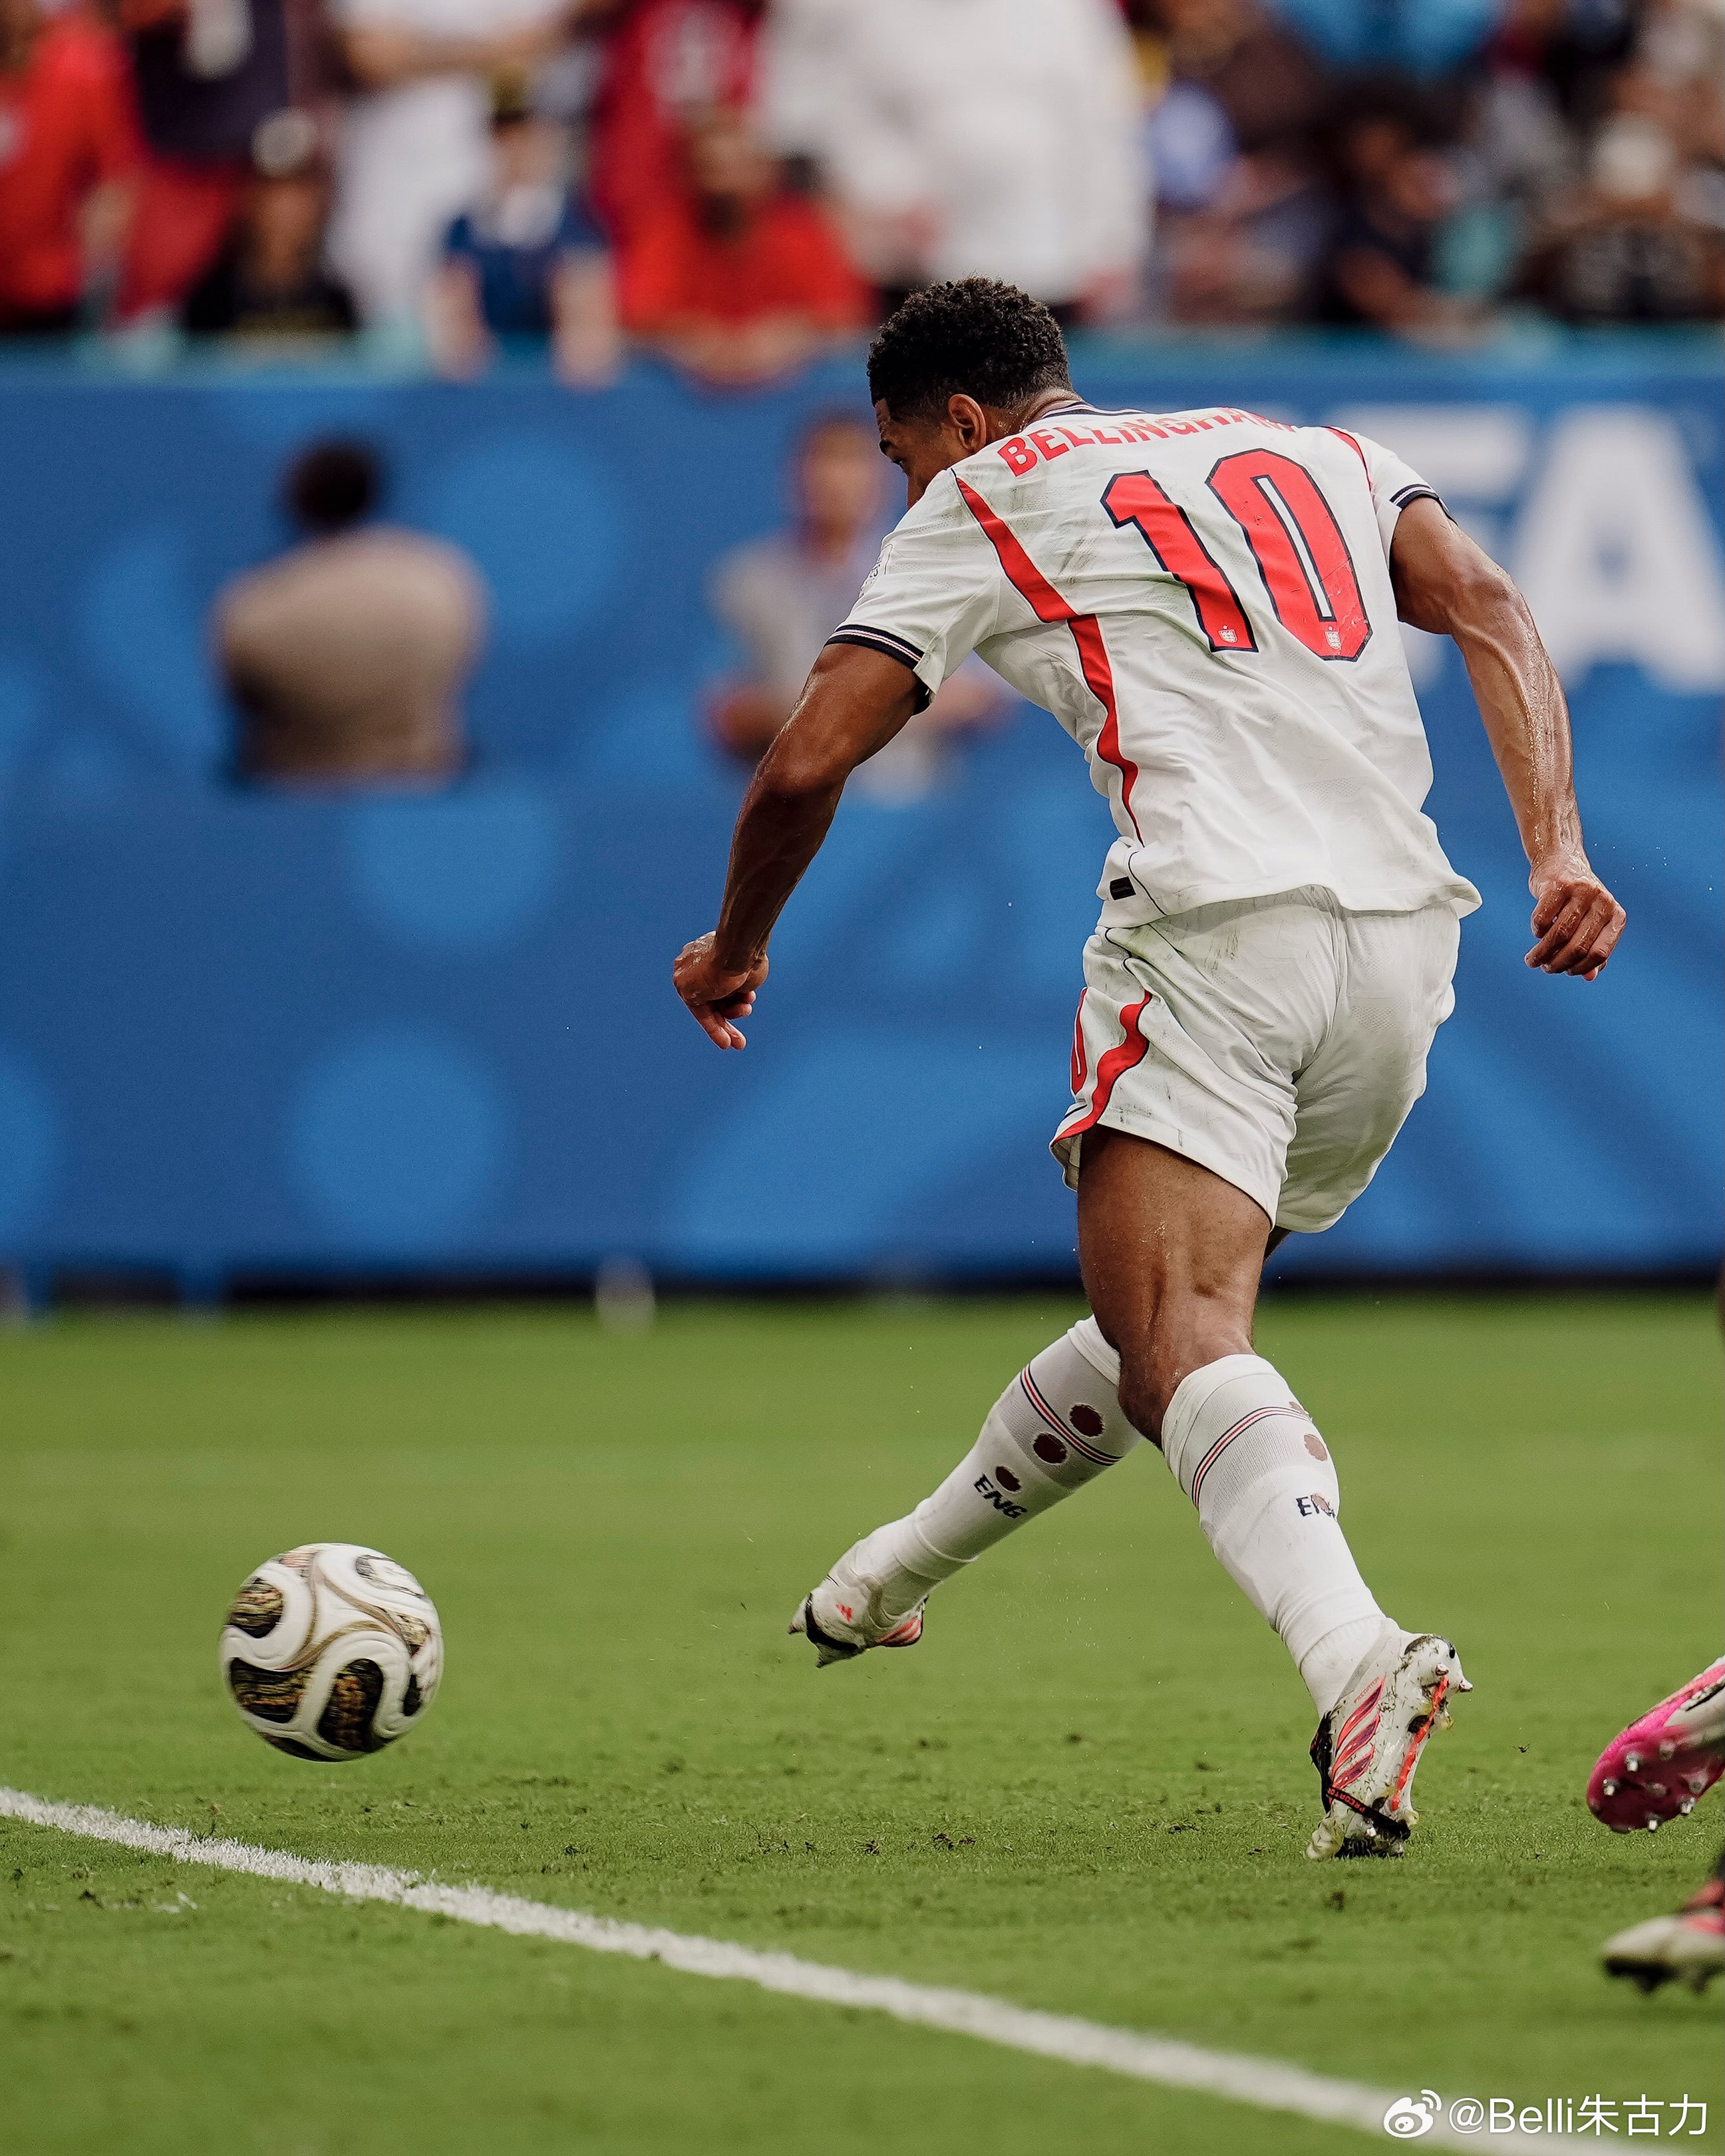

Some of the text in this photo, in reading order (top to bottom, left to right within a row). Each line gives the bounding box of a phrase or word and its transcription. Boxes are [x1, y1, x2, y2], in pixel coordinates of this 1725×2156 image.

[998, 406, 1296, 477] BELLINGHAM
[1100, 448, 1373, 661] 10
[973, 1473, 1027, 1519] ENG
